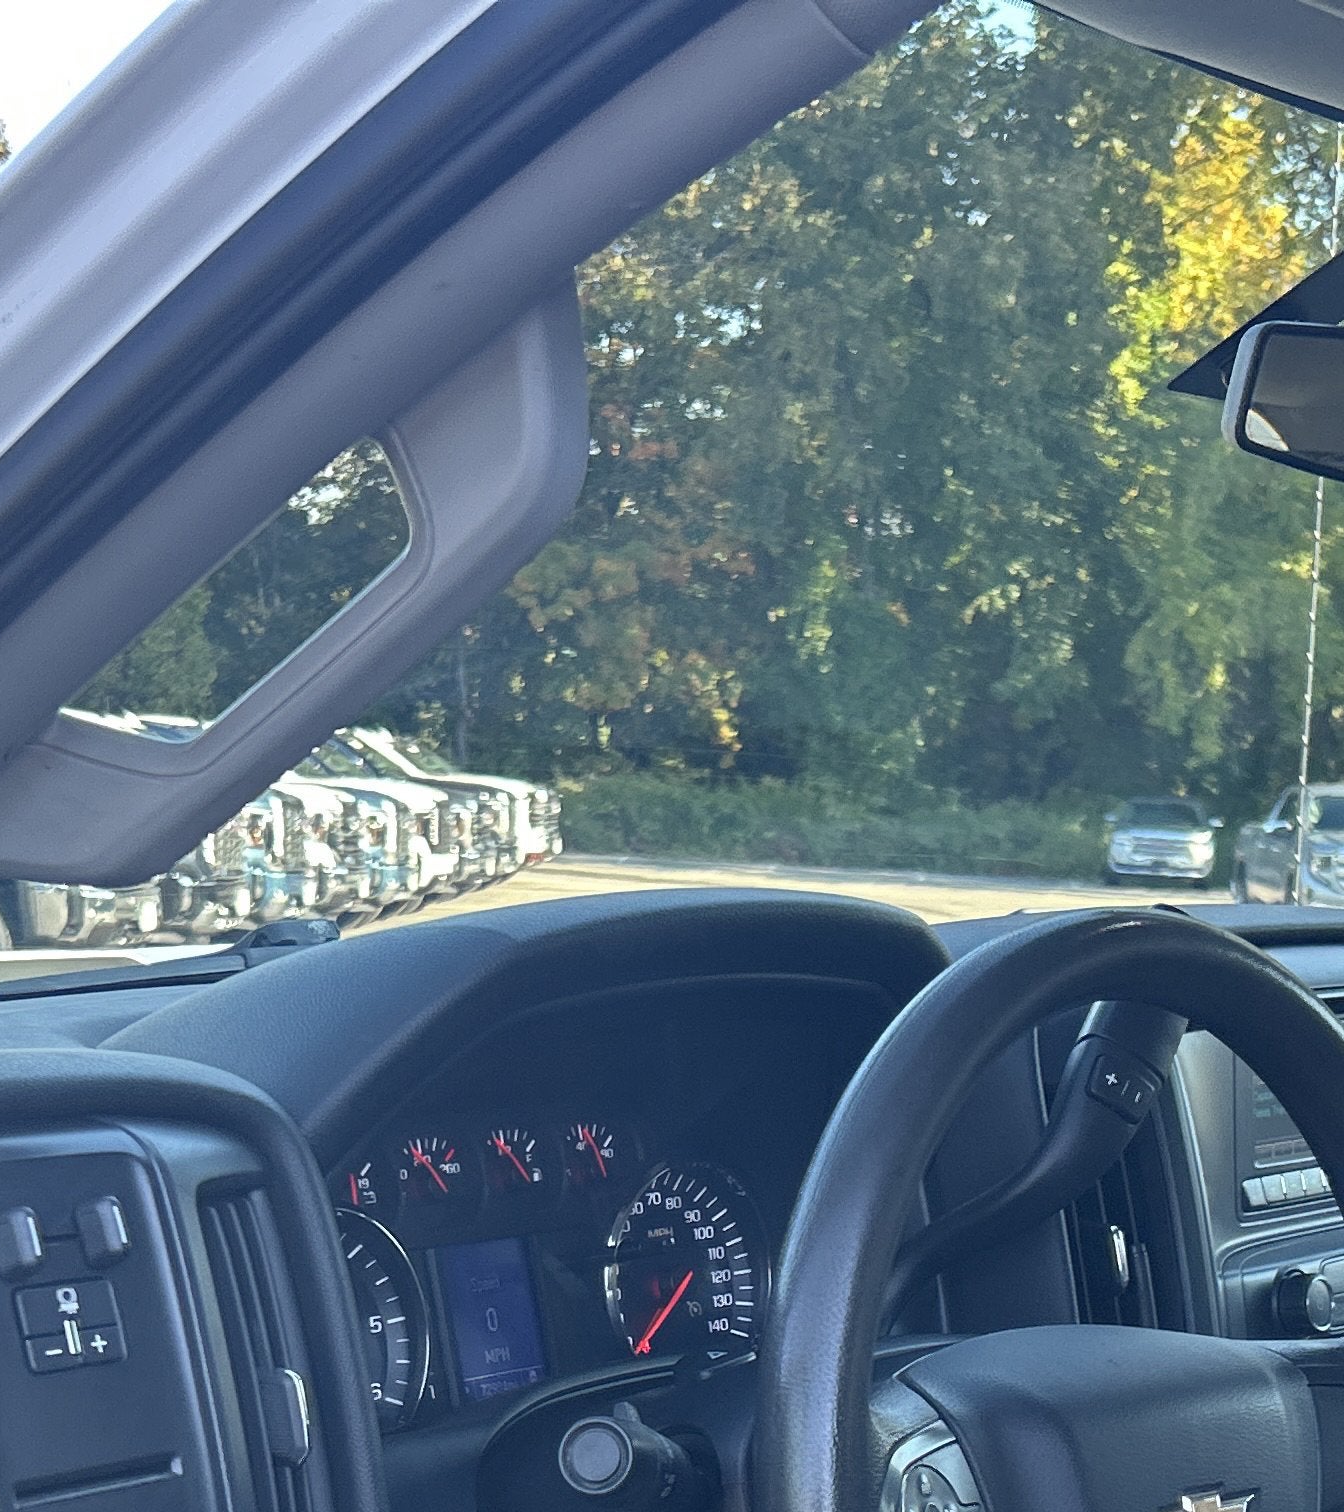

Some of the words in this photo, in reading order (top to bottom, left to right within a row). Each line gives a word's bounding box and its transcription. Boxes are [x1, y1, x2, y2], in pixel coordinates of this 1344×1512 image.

[645, 1191, 663, 1206] 70
[665, 1196, 683, 1210] 80
[684, 1209, 701, 1224] 90
[693, 1225, 715, 1241] 100
[708, 1246, 726, 1260] 110
[711, 1268, 732, 1285] 120
[712, 1293, 733, 1308] 130
[368, 1314, 383, 1334] 5
[708, 1317, 730, 1334] 140
